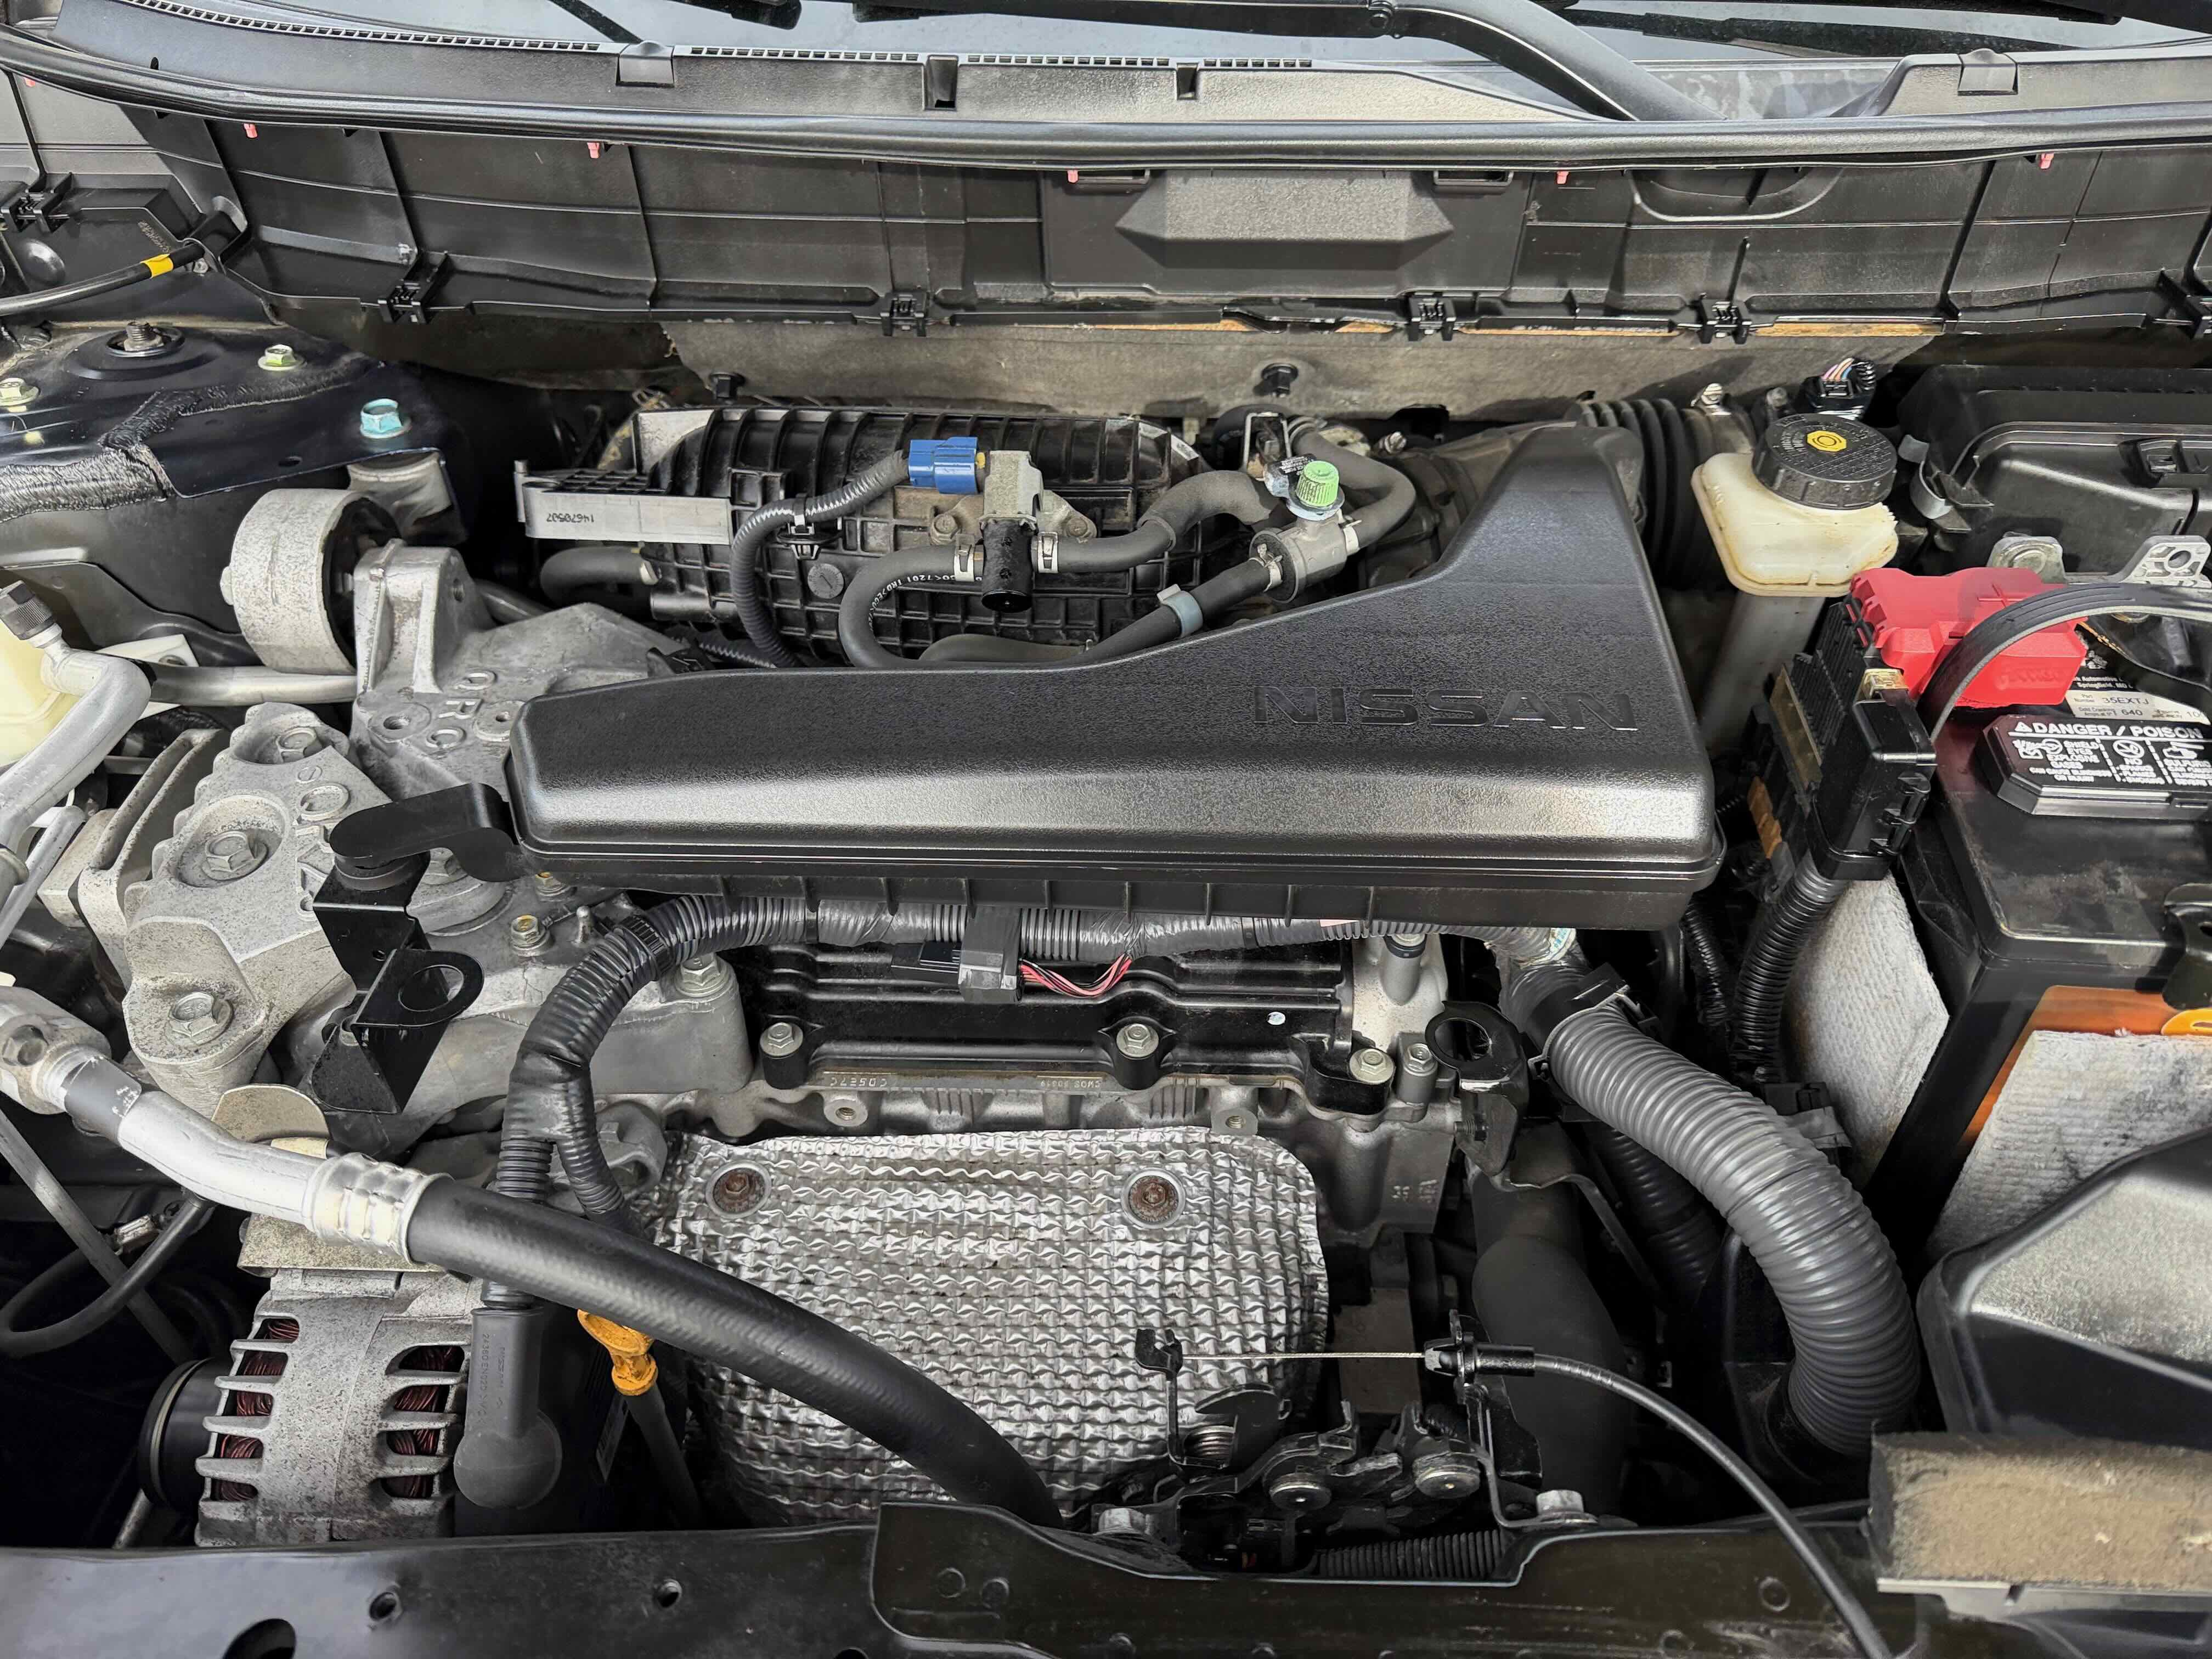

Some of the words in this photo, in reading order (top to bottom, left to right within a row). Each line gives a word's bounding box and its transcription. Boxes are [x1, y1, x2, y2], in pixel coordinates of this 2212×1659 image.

[1253, 686, 1638, 732] NISSAN
[2032, 723, 2112, 736] DANGER
[2130, 726, 2204, 738] POISON
[2063, 741, 2100, 749] SHIELD
